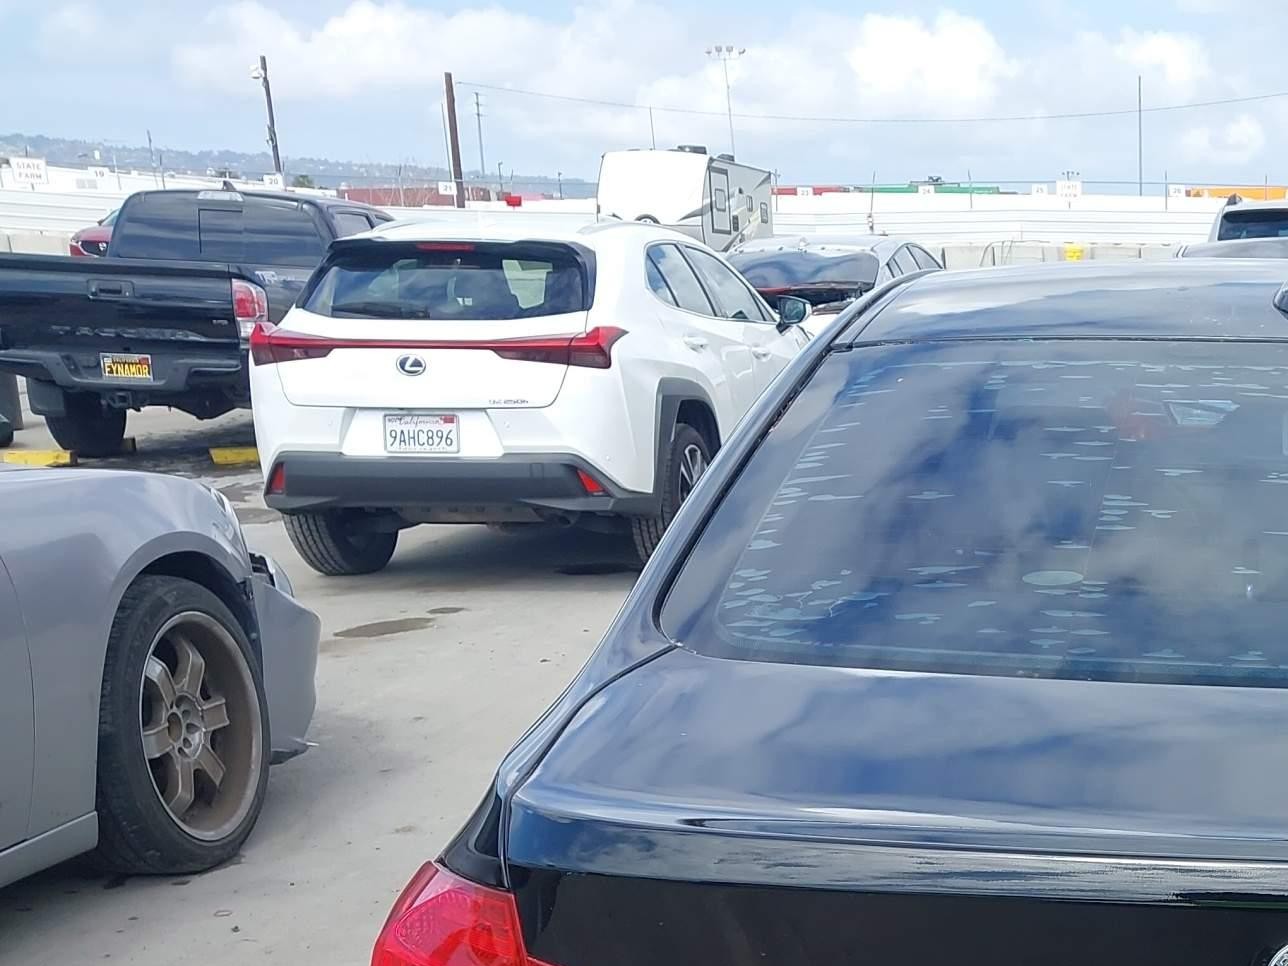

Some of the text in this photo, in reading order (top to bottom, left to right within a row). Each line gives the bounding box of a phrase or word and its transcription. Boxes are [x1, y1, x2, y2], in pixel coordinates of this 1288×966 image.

[16, 161, 41, 170] STATE
[18, 172, 42, 180] FARM
[268, 177, 279, 185] 20
[400, 415, 441, 428] California
[389, 429, 454, 447] 9AHC896
